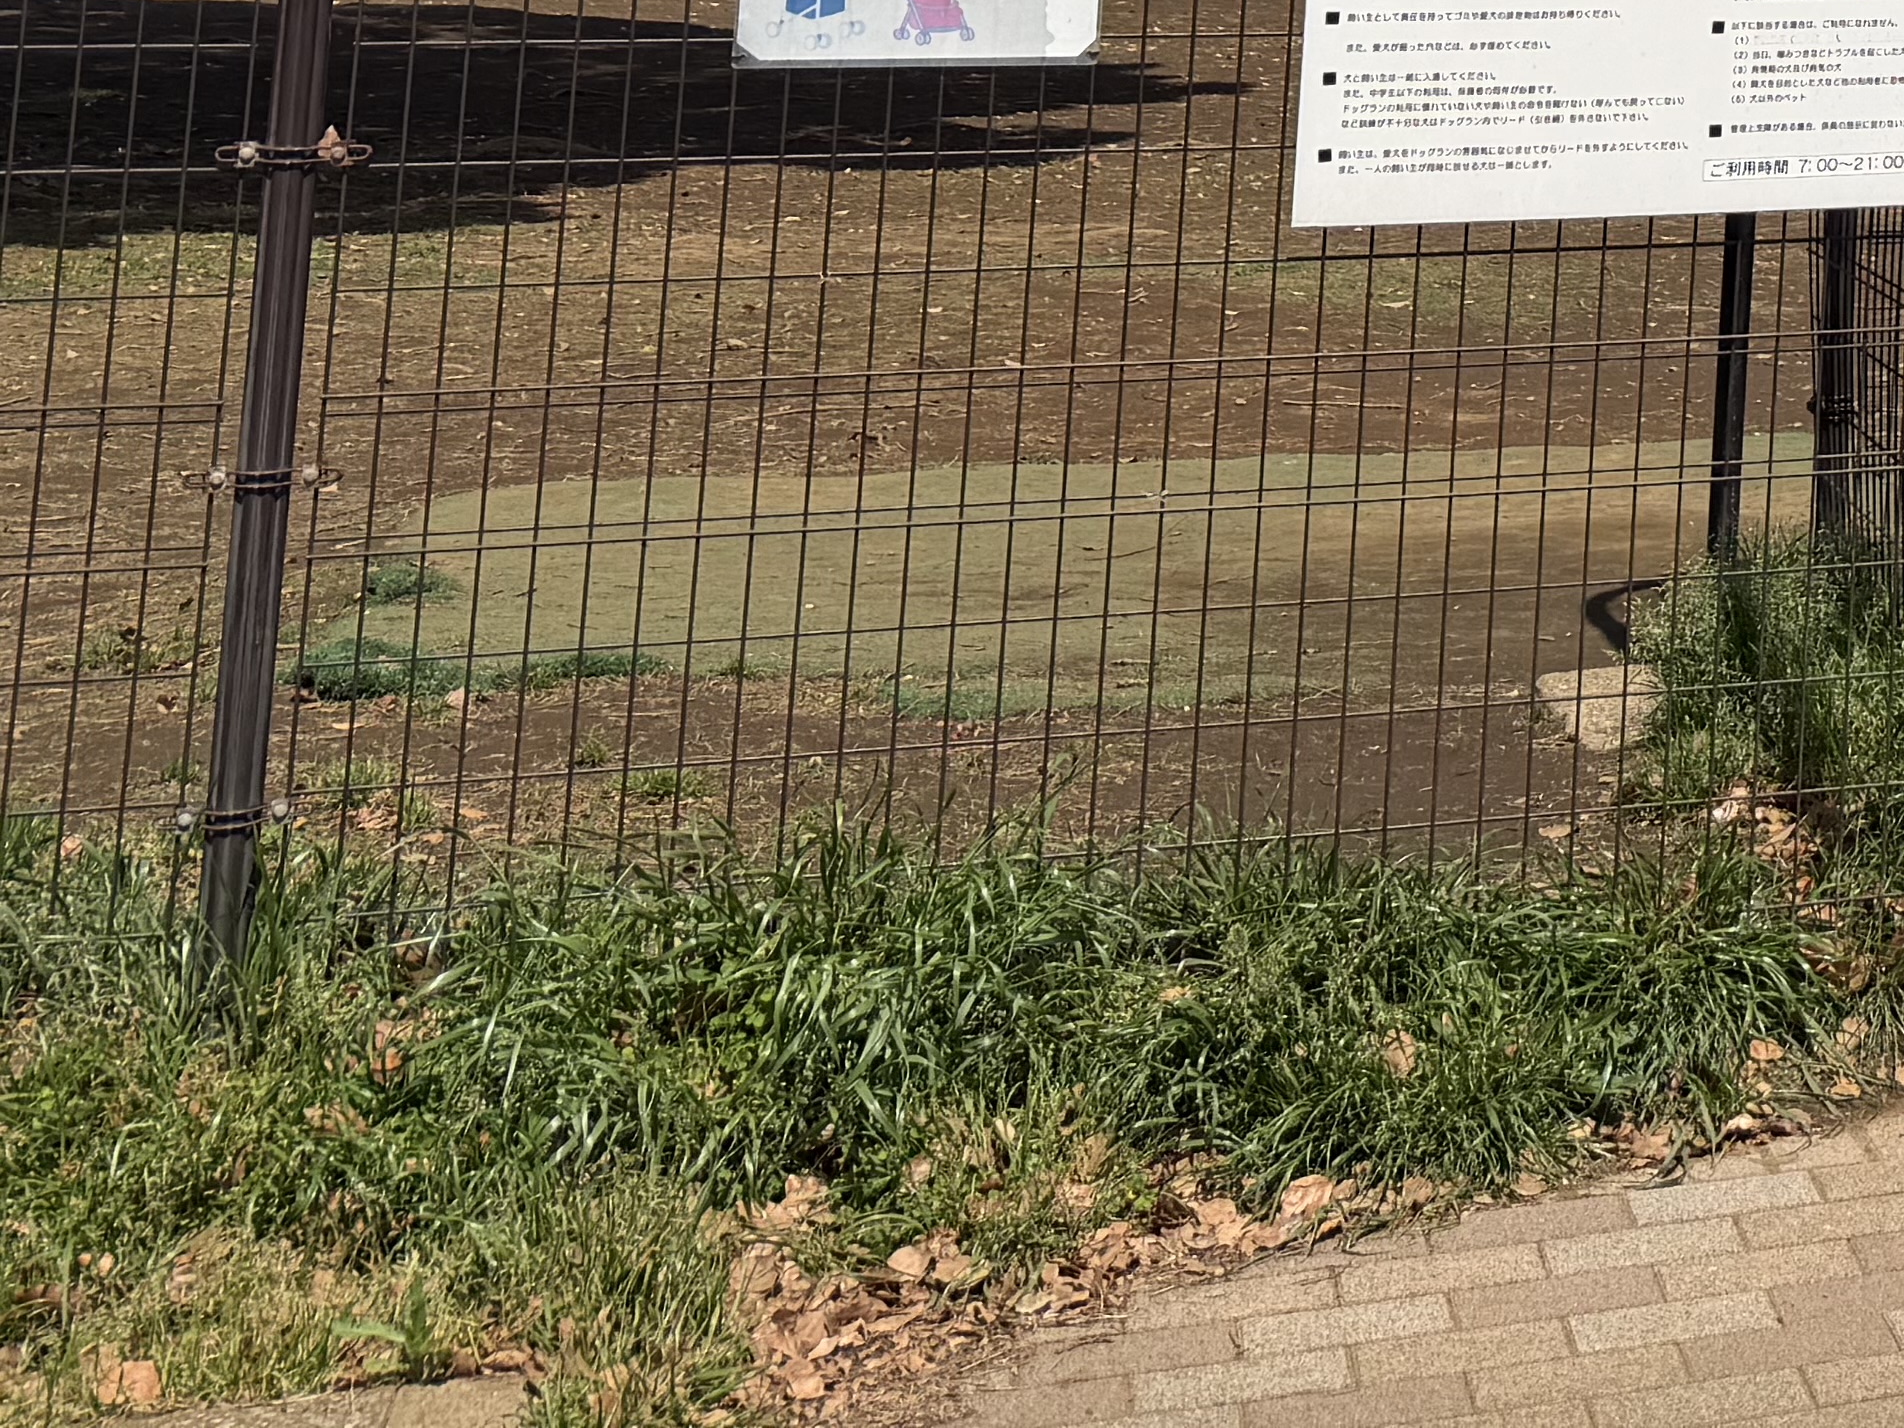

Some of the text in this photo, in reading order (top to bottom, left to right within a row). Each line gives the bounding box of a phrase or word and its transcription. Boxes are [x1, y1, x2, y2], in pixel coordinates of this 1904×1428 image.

[1710, 159, 1789, 178] ご利用時間
